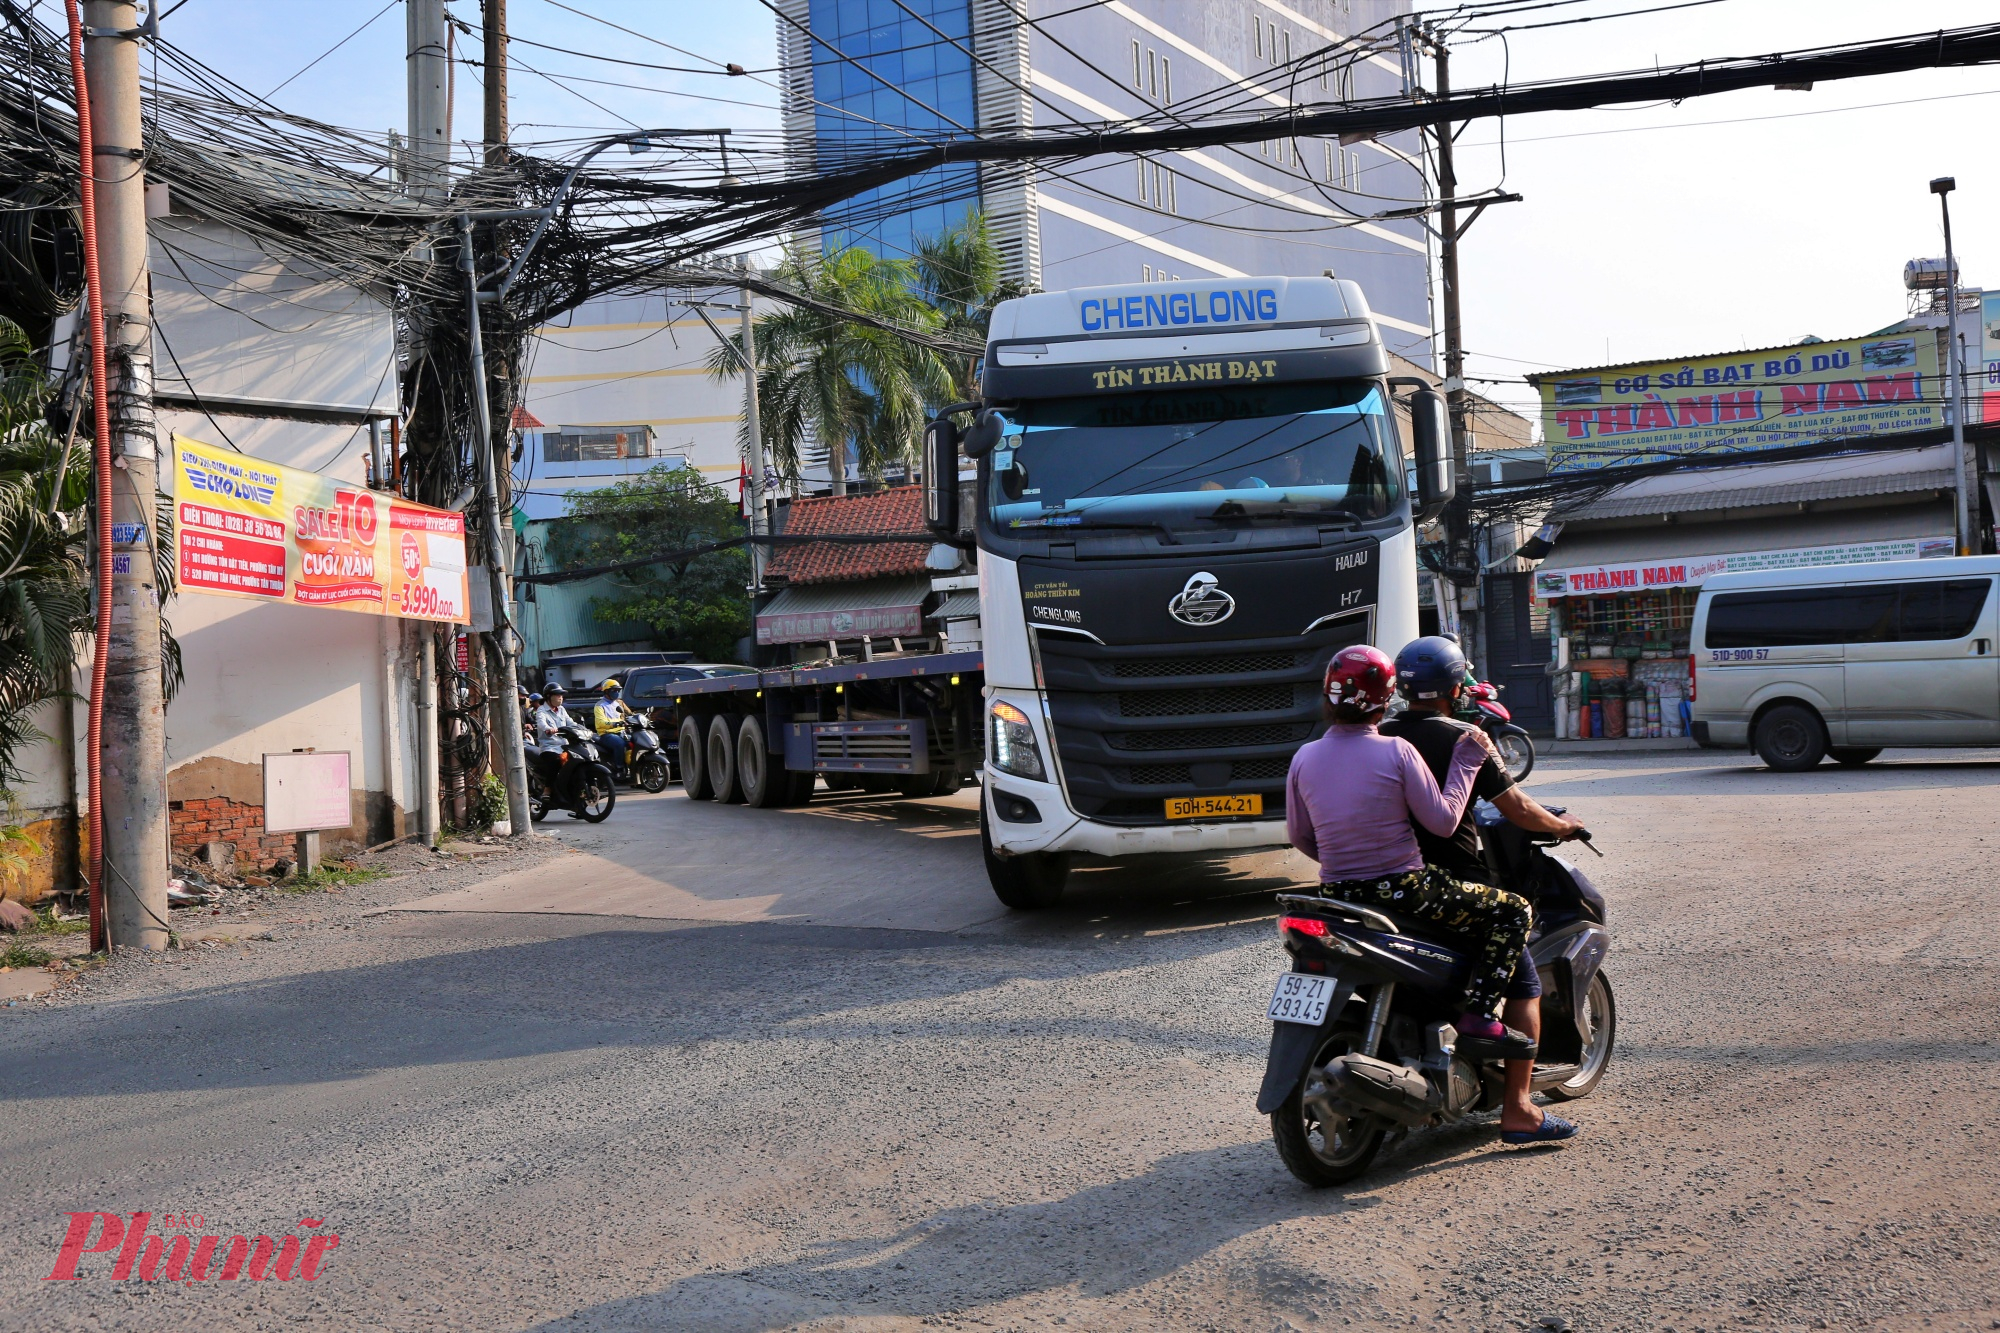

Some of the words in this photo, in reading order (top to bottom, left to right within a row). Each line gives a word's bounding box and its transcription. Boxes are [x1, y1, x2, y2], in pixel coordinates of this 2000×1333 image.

[1081, 289, 1278, 331] CHENGLONG
[1093, 366, 1133, 388] TÍN
[1139, 361, 1222, 384] THÀNH
[1228, 360, 1277, 381] ĐẠT
[1615, 374, 1649, 394] CƠ
[1659, 366, 1694, 389] SỞ
[1704, 364, 1755, 385] BẠT
[1765, 352, 1801, 377] BỐ
[1812, 350, 1850, 371] DÙ
[1556, 390, 1763, 439] THÀNH
[1780, 372, 1923, 416] NAM
[1552, 443, 1577, 452] CHUYÊN
[1598, 440, 1620, 448] DOANH
[1622, 437, 1635, 445] CÁC
[1638, 436, 1652, 444] LOẠI
[1655, 434, 1667, 444] BẠT
[1670, 432, 1682, 440] TÀU
[1689, 431, 1701, 440] BẠT
[1716, 427, 1725, 436] TẢI
[1764, 422, 1781, 430] HIÊN
[1789, 421, 1802, 430] BẠT
[1821, 416, 1834, 425] XẾP
[1842, 414, 1856, 424] BẠT
[1871, 408, 1899, 420] THUYỀN
[1907, 408, 1917, 416] CA
[1920, 406, 1930, 414] NÔ
[1684, 441, 1698, 449] CÁO
[1737, 436, 1748, 444] TAY
[1756, 434, 1766, 442] DÙ
[1769, 432, 1780, 442] HỘI
[1850, 424, 1870, 432] VƯỜN
[1879, 421, 1889, 429] DÙ
[1892, 419, 1911, 429] LỆCH
[1915, 417, 1931, 426] TÂM
[182, 452, 198, 464] SIÊU
[212, 460, 227, 472] ĐIỆN
[229, 464, 243, 478] MÁY
[249, 470, 260, 483] NỘI
[262, 473, 277, 486] THẤT
[208, 474, 234, 499] CHỢ
[184, 506, 200, 526] ĐIỆN
[202, 511, 224, 530] THOẠI:
[226, 516, 242, 532] (028)
[245, 519, 253, 534] 38
[255, 521, 264, 536] 56
[294, 506, 340, 542] SALE
[335, 488, 378, 545] TO
[183, 535, 191, 547] TẠI
[192, 537, 196, 546] 2
[197, 538, 205, 548] CHI
[206, 538, 223, 551] NHÁNH:
[201, 552, 217, 566] ĐƯỜNG
[250, 561, 267, 573] PHƯỜNG
[303, 546, 340, 576] CUỐI
[341, 550, 373, 577] NĂM
[404, 548, 420, 569] 50%
[1336, 550, 1367, 571] HALAU
[192, 569, 201, 580] 520
[203, 569, 218, 582] HUỲNH
[242, 575, 259, 587] PHƯỜNG
[1570, 568, 1637, 591] THÀNH
[1643, 565, 1687, 584] NAM
[1691, 564, 1706, 578] Chuyên
[1707, 562, 1716, 573] May
[1717, 559, 1726, 571] Bạt:
[298, 590, 308, 600] ĐỢT
[309, 590, 320, 600] GIẢM
[328, 591, 337, 600] LỤC
[362, 586, 371, 595] NĂM
[401, 583, 453, 618] 3.990.000
[1025, 590, 1047, 598] HOÀNG
[1048, 588, 1067, 597] THIÊN
[1341, 588, 1362, 606] H7
[813, 618, 830, 634] HUY
[1033, 605, 1081, 623] CHENGLONG
[1174, 798, 1252, 815] 50H-544.21
[1284, 976, 1325, 999] 59-Z1
[1271, 997, 1324, 1021] 293.45
